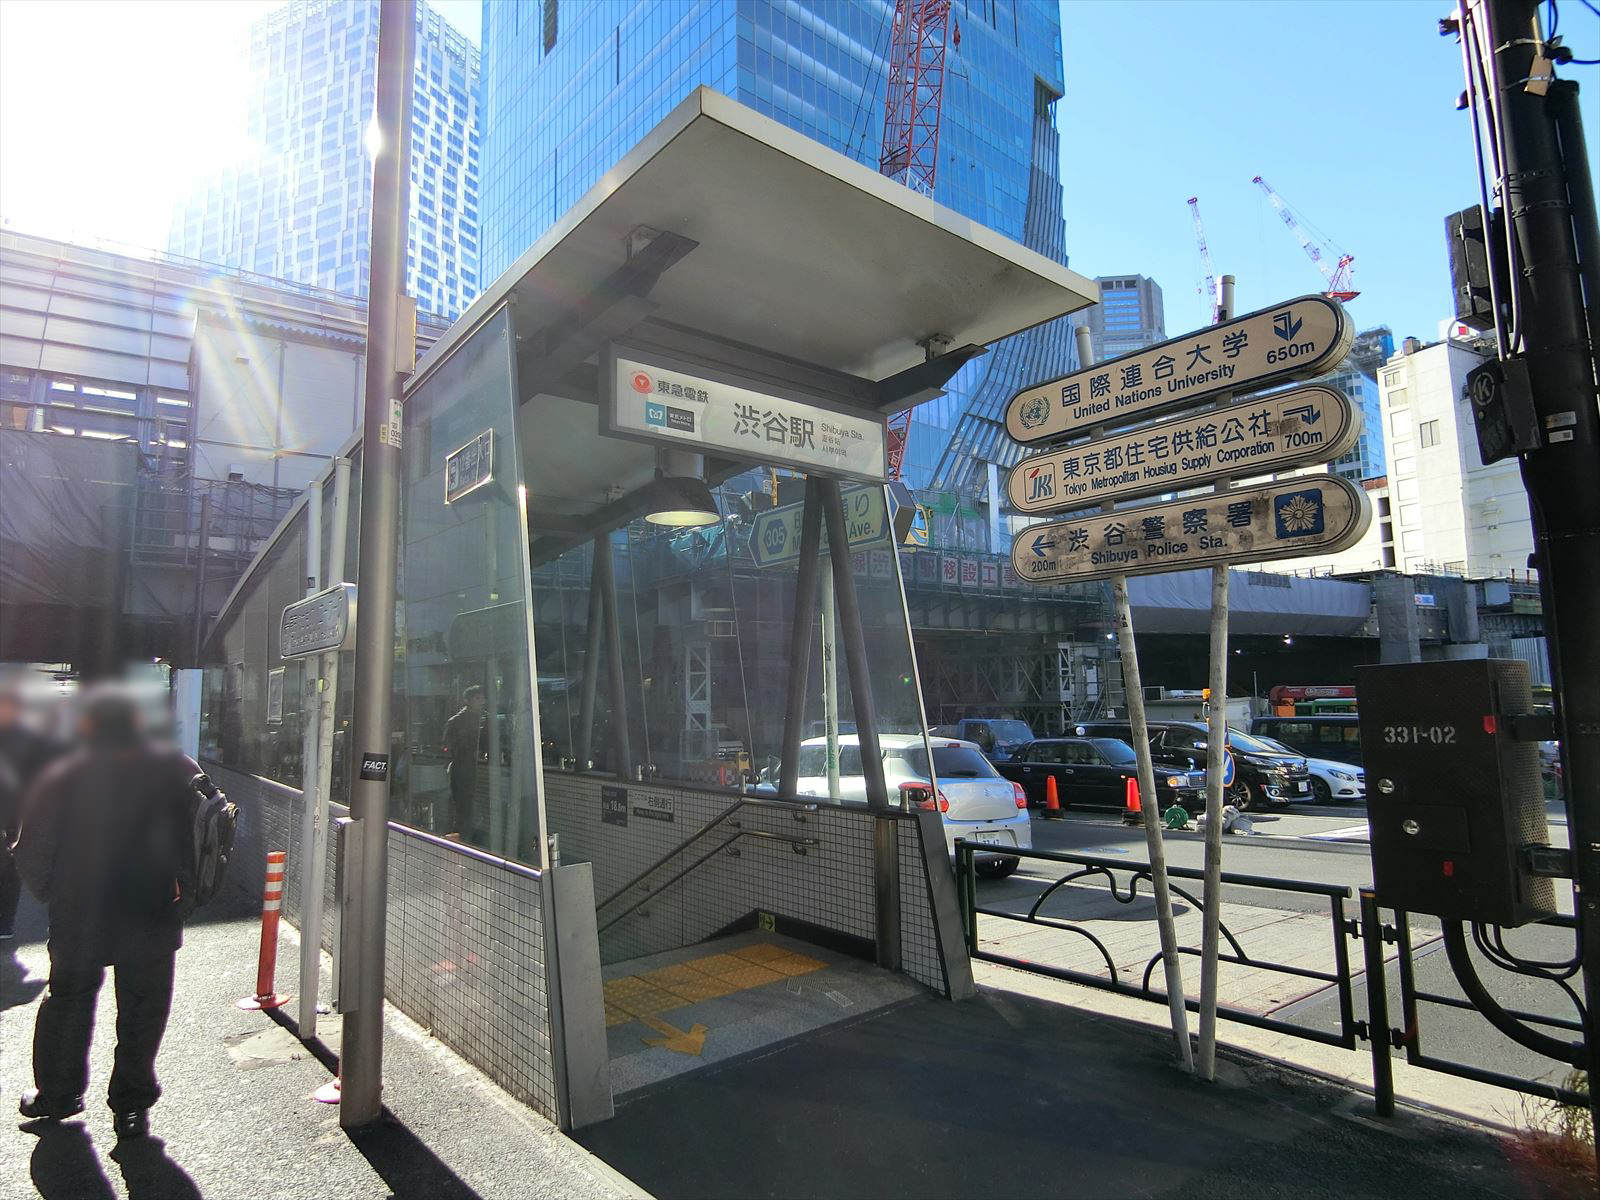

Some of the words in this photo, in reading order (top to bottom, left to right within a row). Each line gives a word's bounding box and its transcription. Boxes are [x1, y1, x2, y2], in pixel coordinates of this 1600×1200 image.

[1266, 341, 1315, 365] 650m
[1062, 329, 1249, 407] 国際連合大学
[657, 380, 709, 404] 東急電鉄
[1073, 400, 1111, 420] United
[1115, 384, 1162, 409] Nations
[1167, 364, 1236, 393] University
[733, 402, 815, 450] 渋谷駅
[821, 422, 850, 439] Shibuya
[850, 430, 864, 441] Sta.
[1062, 408, 1272, 481] 東京都住宅供給公社
[1284, 431, 1323, 449] 700m
[1063, 482, 1088, 496] Tokyo
[1091, 471, 1140, 490] Metropolitan
[1181, 453, 1212, 471] Supply
[1216, 441, 1275, 463] Corporation
[765, 526, 785, 548] 305
[848, 522, 875, 539] Ave.
[1068, 501, 1254, 552] 渋谷警察署
[1091, 549, 1138, 566] Shibuya
[1147, 541, 1189, 557] Police
[1199, 536, 1228, 550] Sta.
[1031, 560, 1057, 573] 200m
[1384, 726, 1456, 744] 331-02
[363, 760, 387, 770] FACT.
